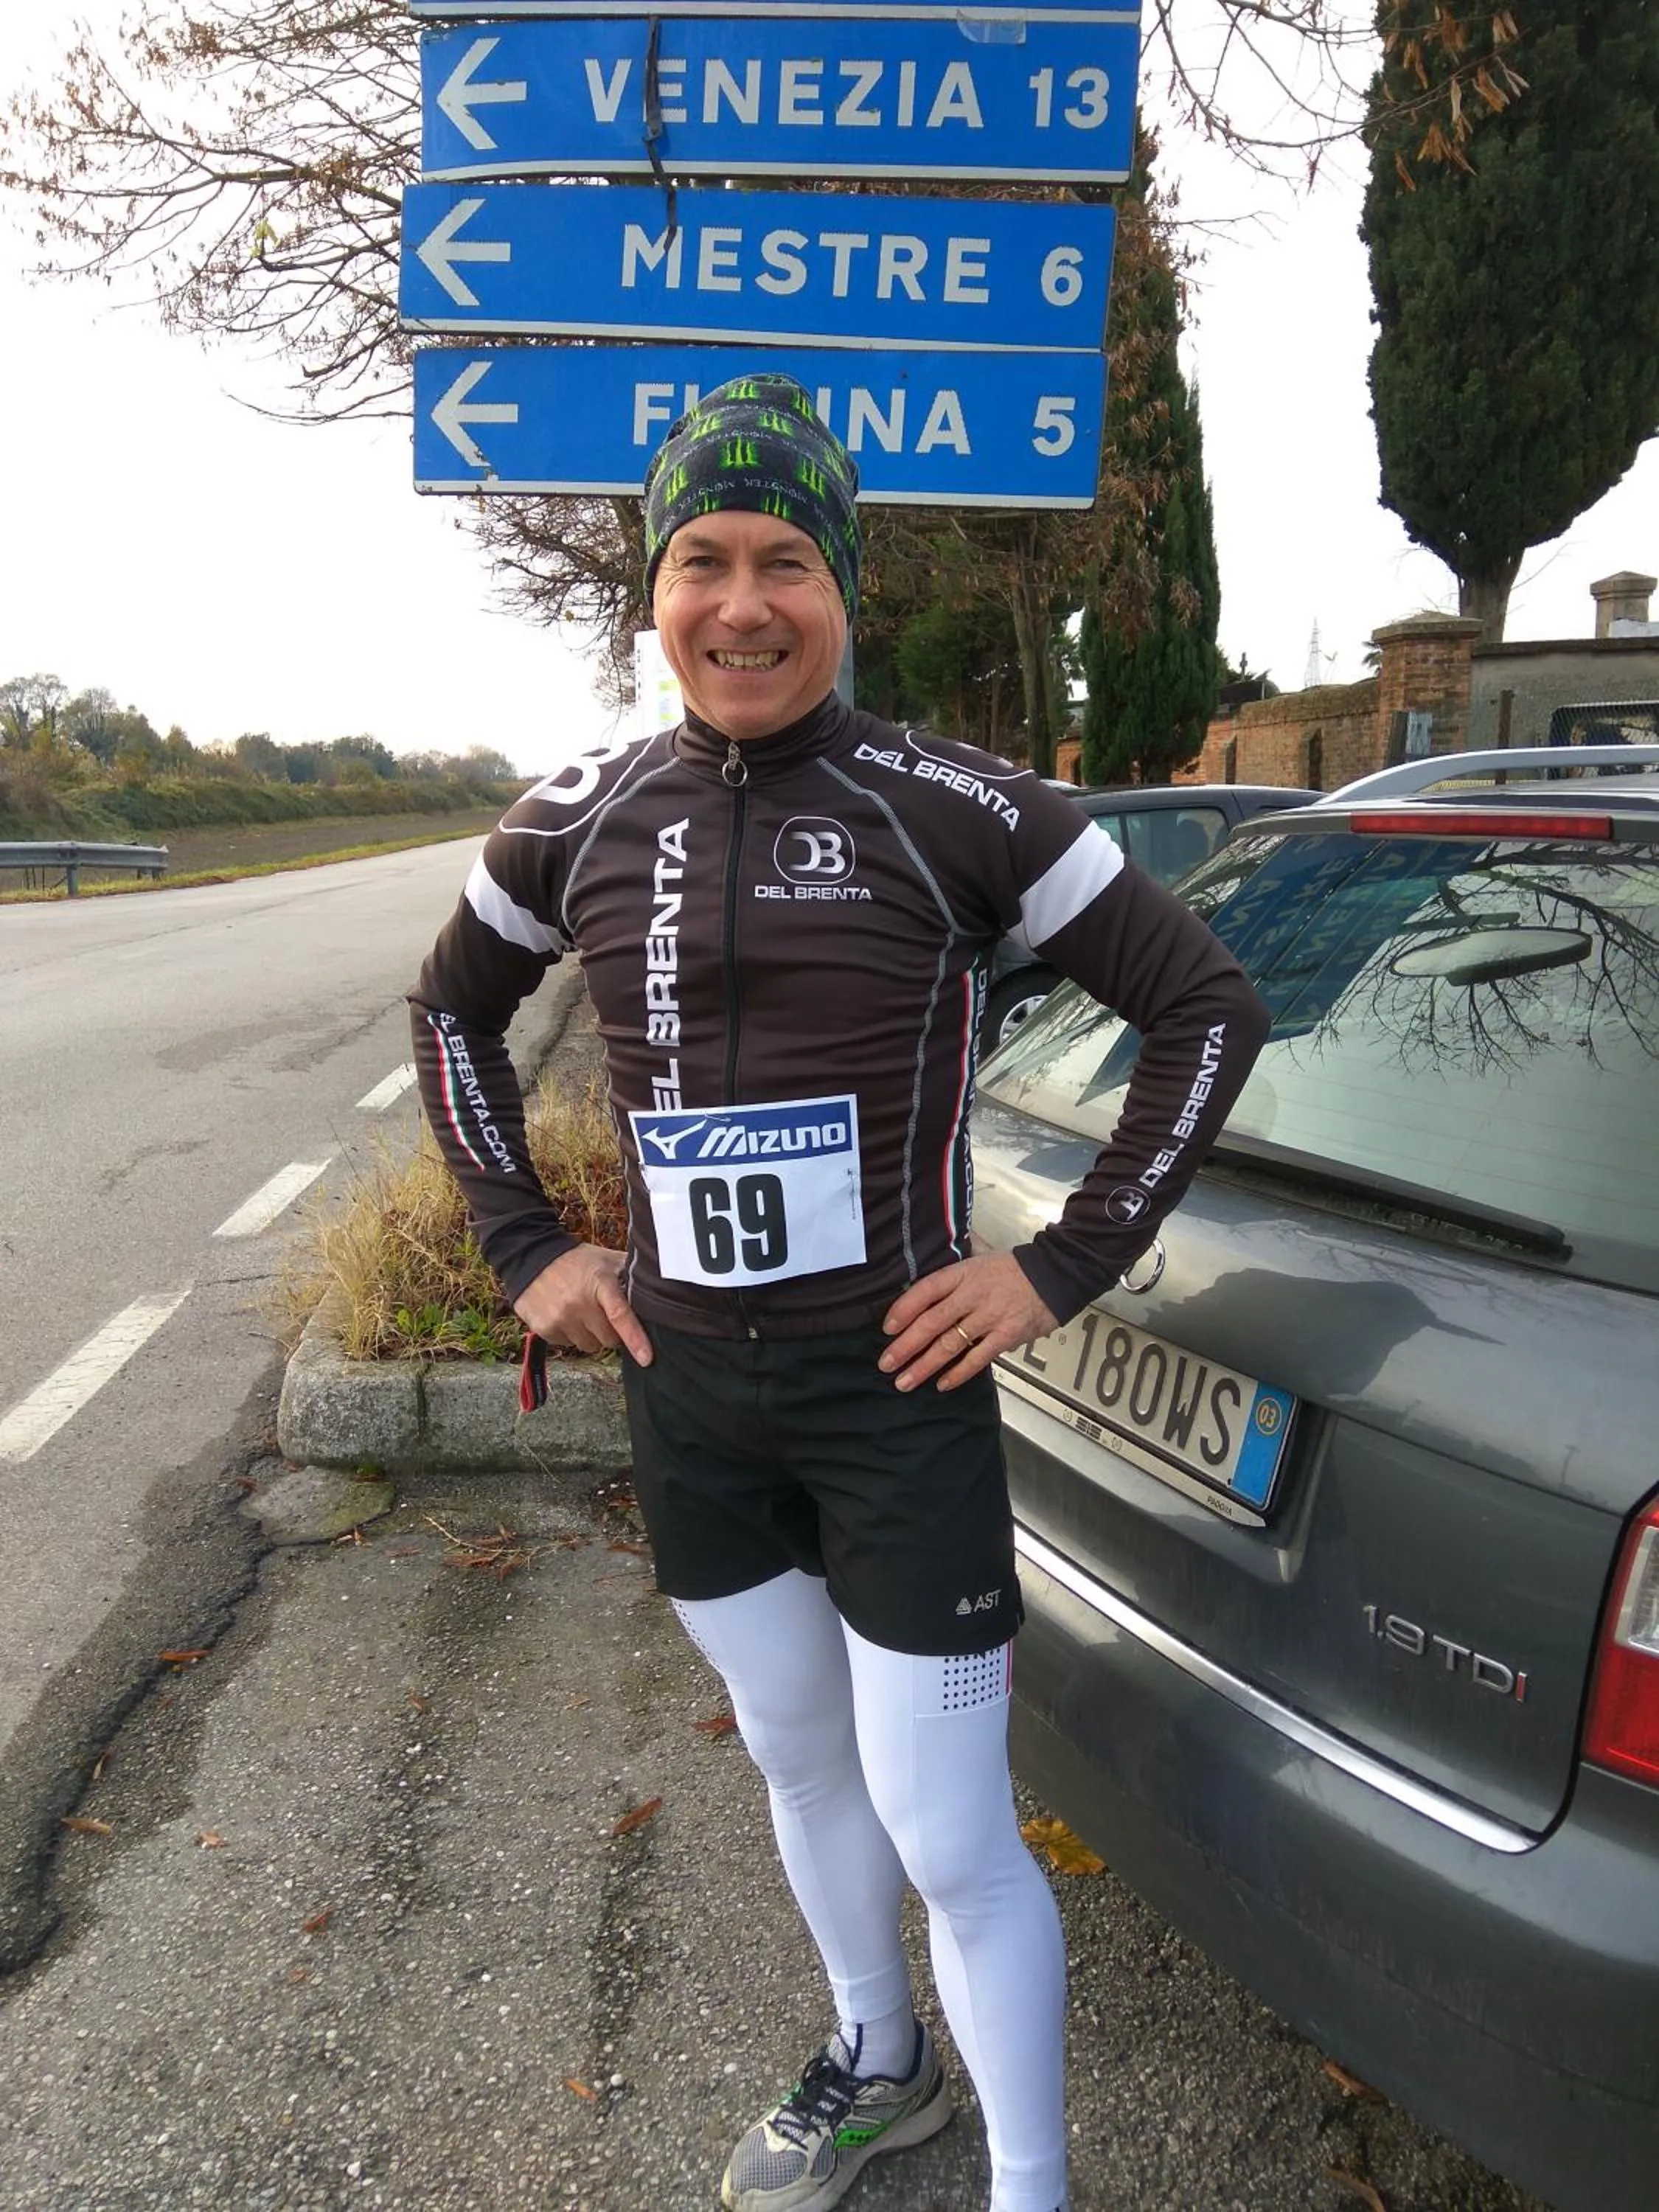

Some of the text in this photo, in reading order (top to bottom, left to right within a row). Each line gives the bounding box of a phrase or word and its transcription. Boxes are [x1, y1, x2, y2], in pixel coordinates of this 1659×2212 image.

[583, 58, 1110, 129] VENEZIA 13
[621, 223, 1085, 307] MESTRE 6
[633, 382, 1075, 457] FINA 5
[852, 742, 1020, 832] DEL BRENTA
[754, 885, 873, 900] DEL BRENTA
[645, 818, 690, 1112] EL BRENTA
[448, 1034, 516, 1173] BRENTA.COM
[1139, 1022, 1227, 1188] DEL BRENTA
[689, 1173, 789, 1275] 69
[1074, 1313, 1241, 1466] 180WS
[1259, 1404, 1276, 1429] 03
[974, 1589, 1002, 1613] AST
[1363, 1604, 1425, 1656] 1.9
